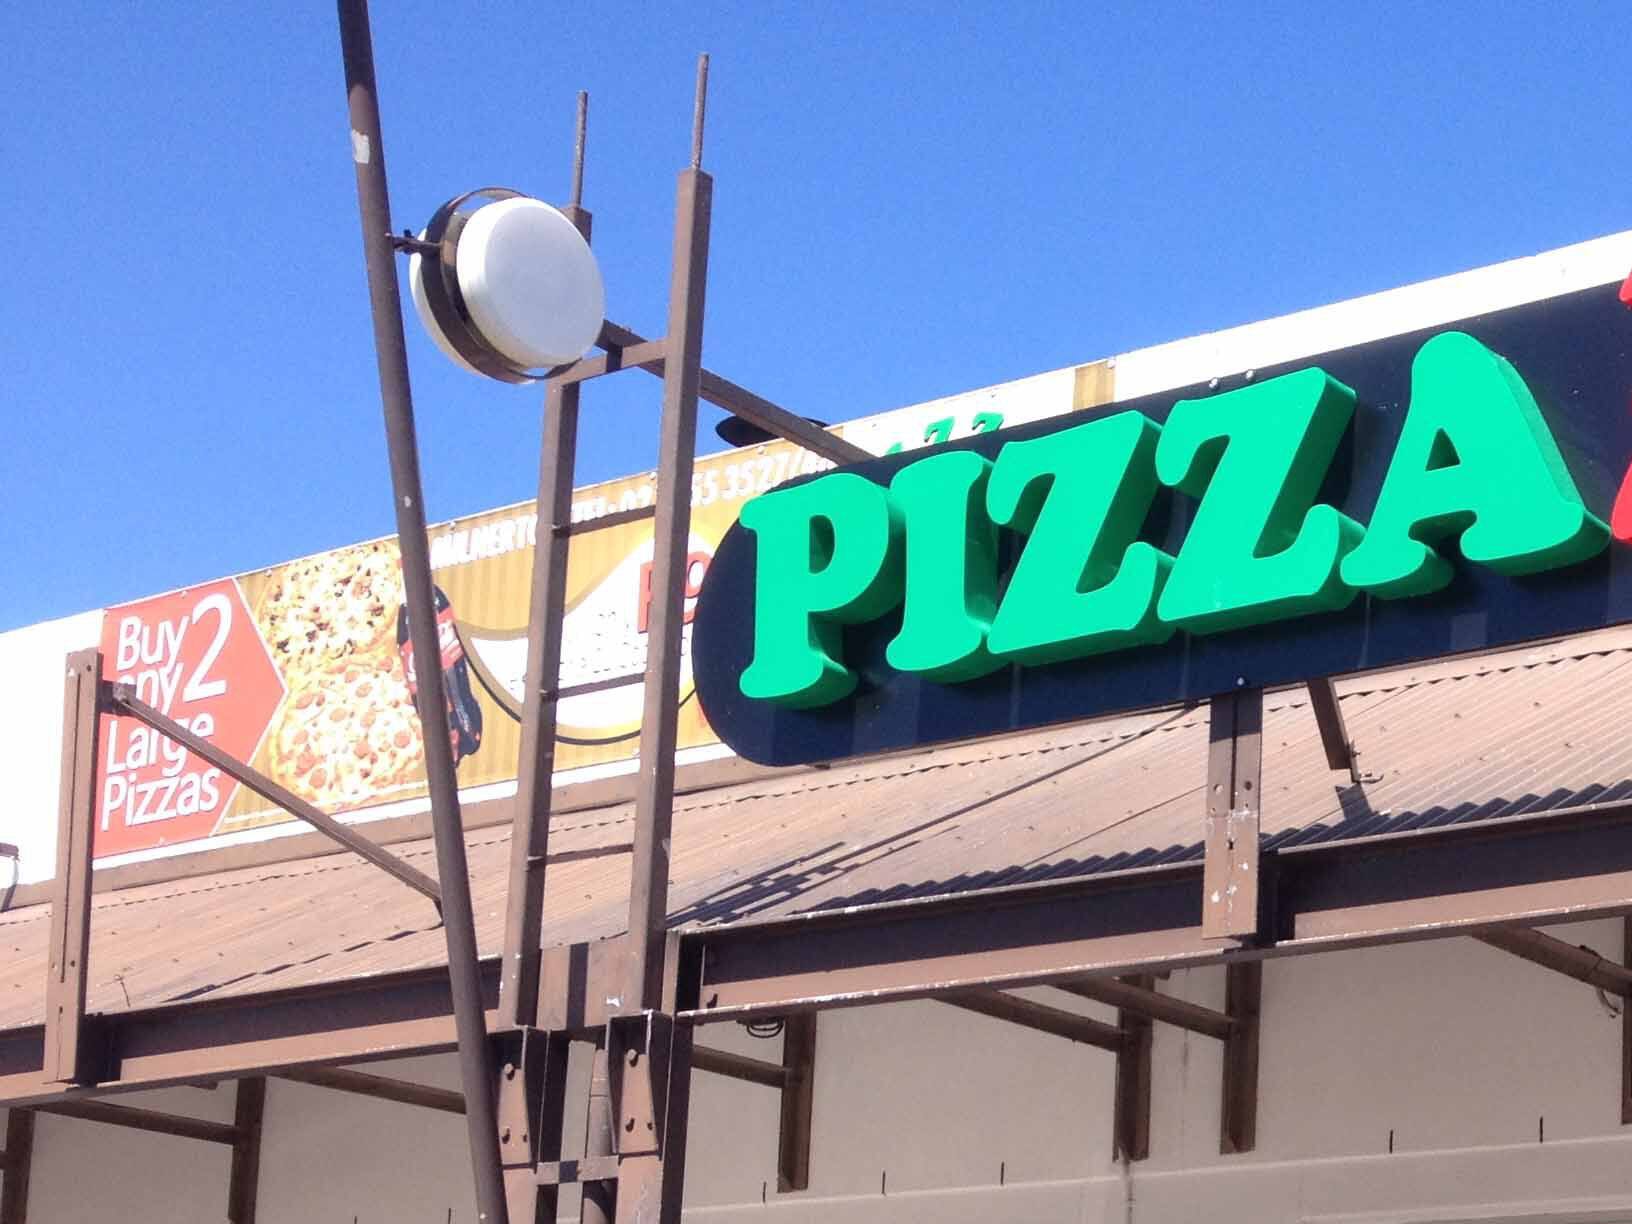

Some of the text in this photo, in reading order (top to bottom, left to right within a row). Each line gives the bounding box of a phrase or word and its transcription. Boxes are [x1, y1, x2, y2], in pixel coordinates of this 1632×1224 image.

[739, 330, 1610, 708] PIZZA
[116, 615, 190, 671] Buy
[118, 592, 233, 719] ny 2
[101, 767, 222, 832] Pizzas
